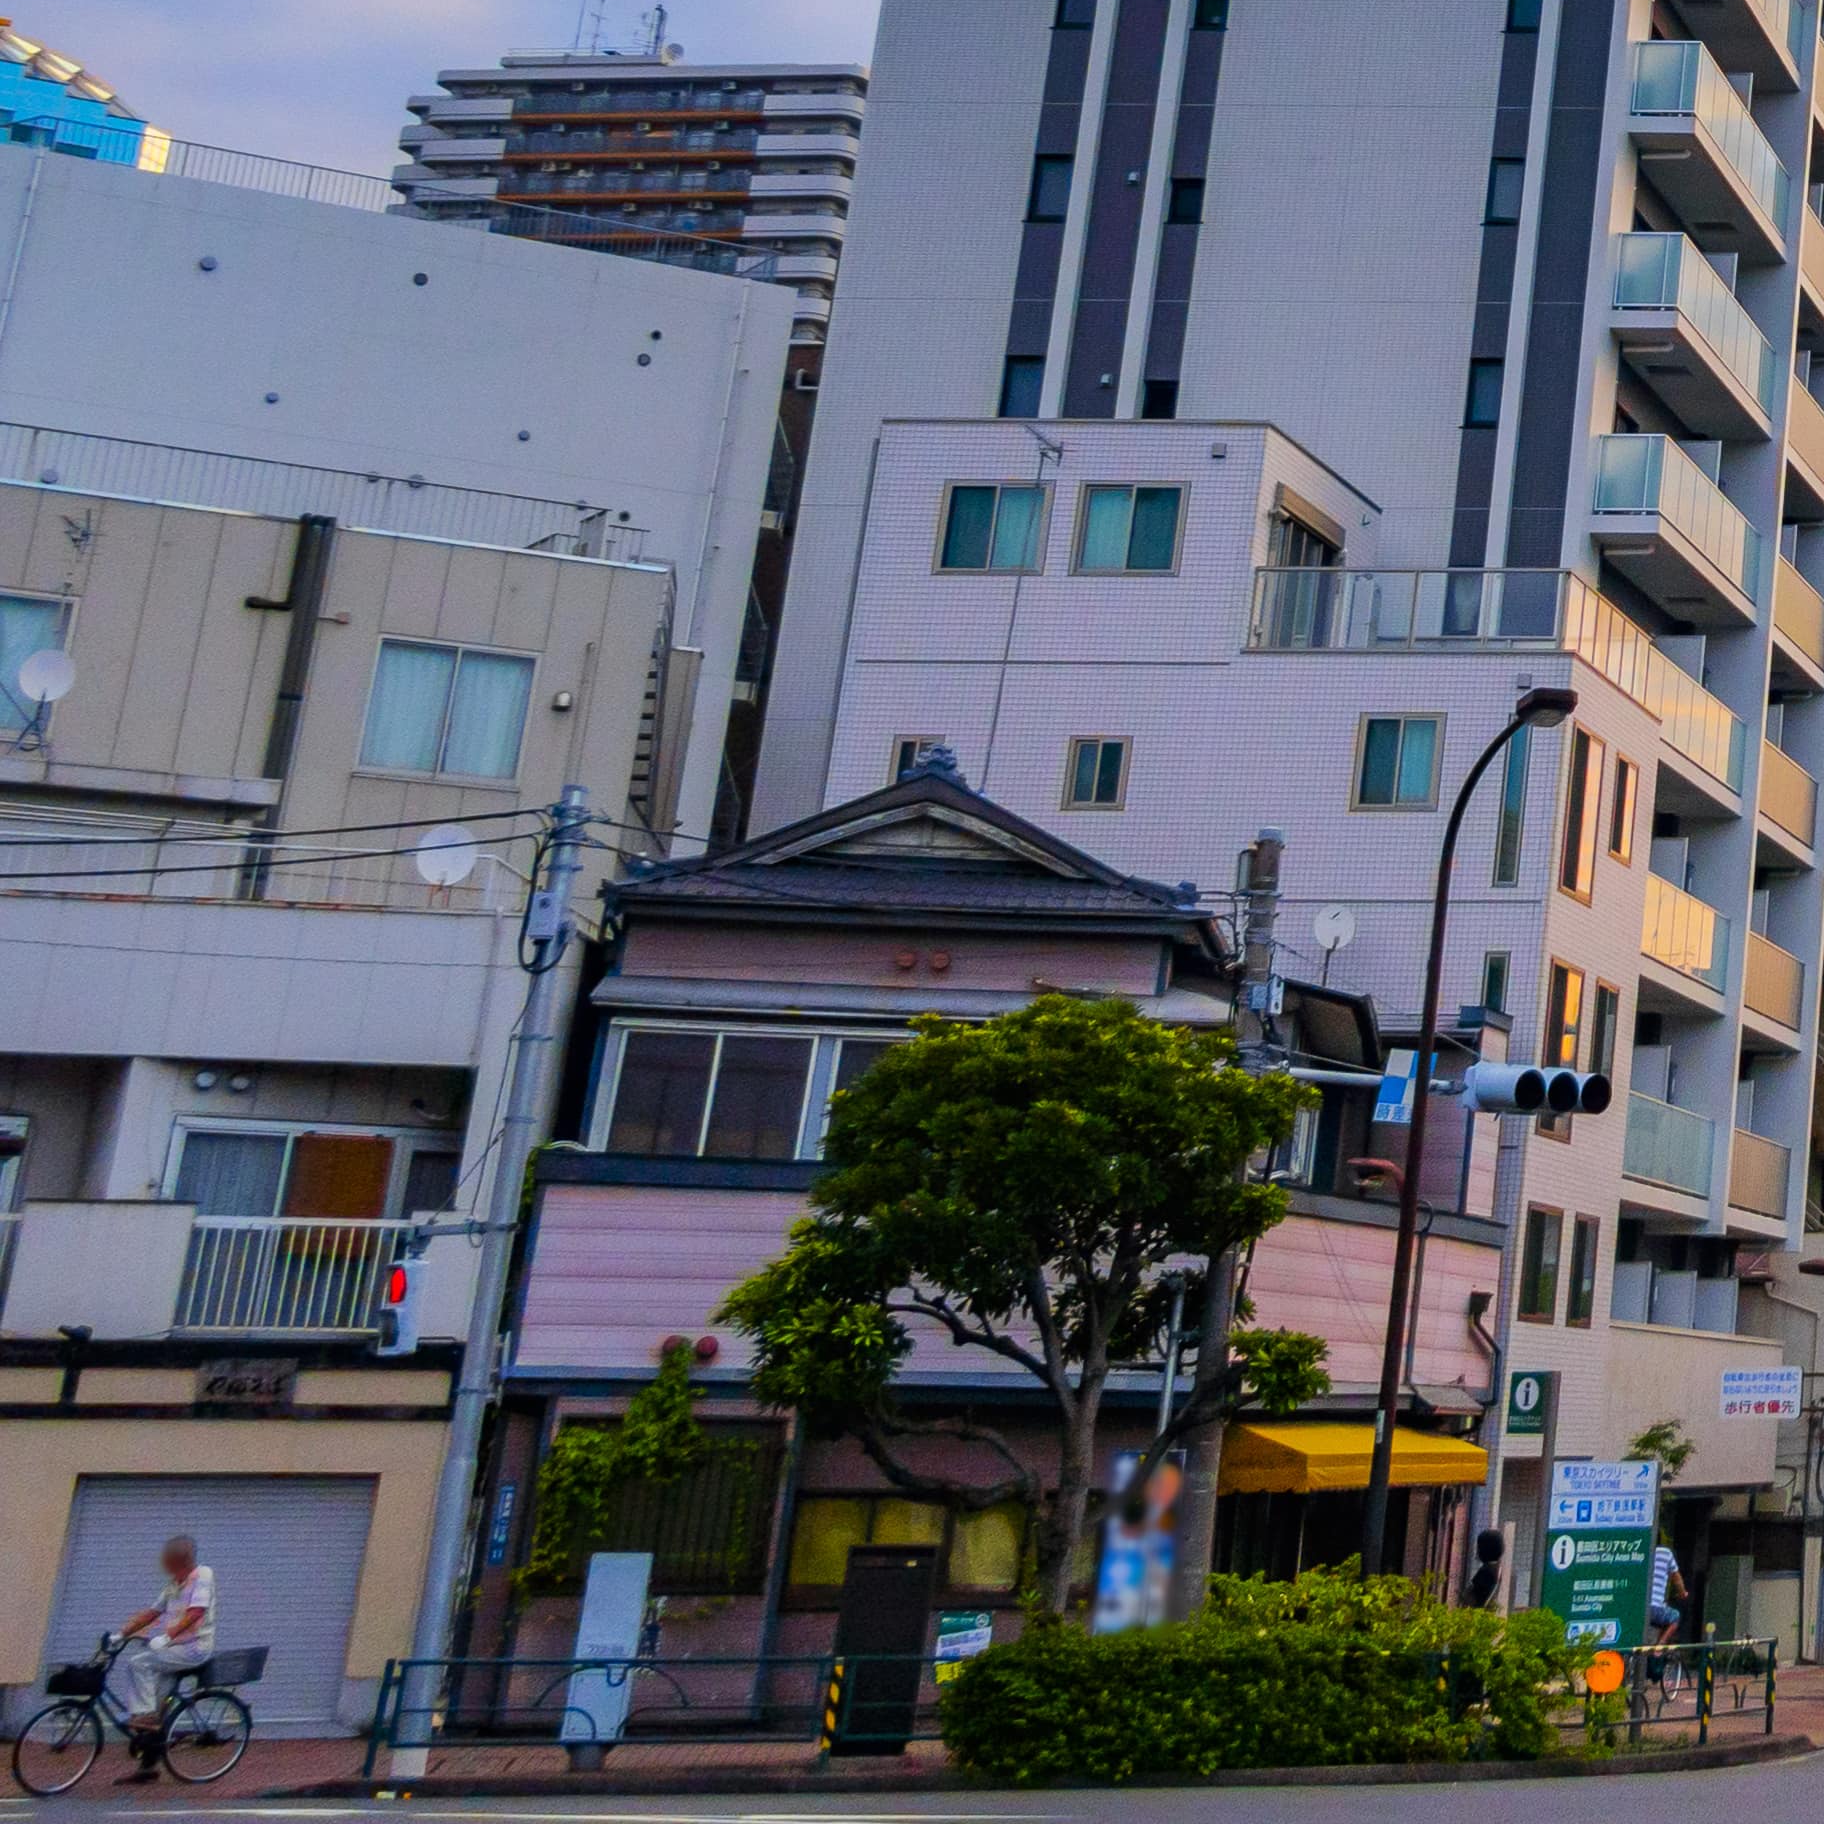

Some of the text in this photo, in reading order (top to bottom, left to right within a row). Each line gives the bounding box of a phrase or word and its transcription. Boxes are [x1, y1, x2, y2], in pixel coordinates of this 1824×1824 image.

[1724, 1399, 1796, 1415] 歩行者優先
[1563, 1465, 1629, 1478] 東京スカイツリー
[1601, 1553, 1614, 1565] City
[1614, 1553, 1631, 1562] Area
[1631, 1552, 1645, 1563] Map
